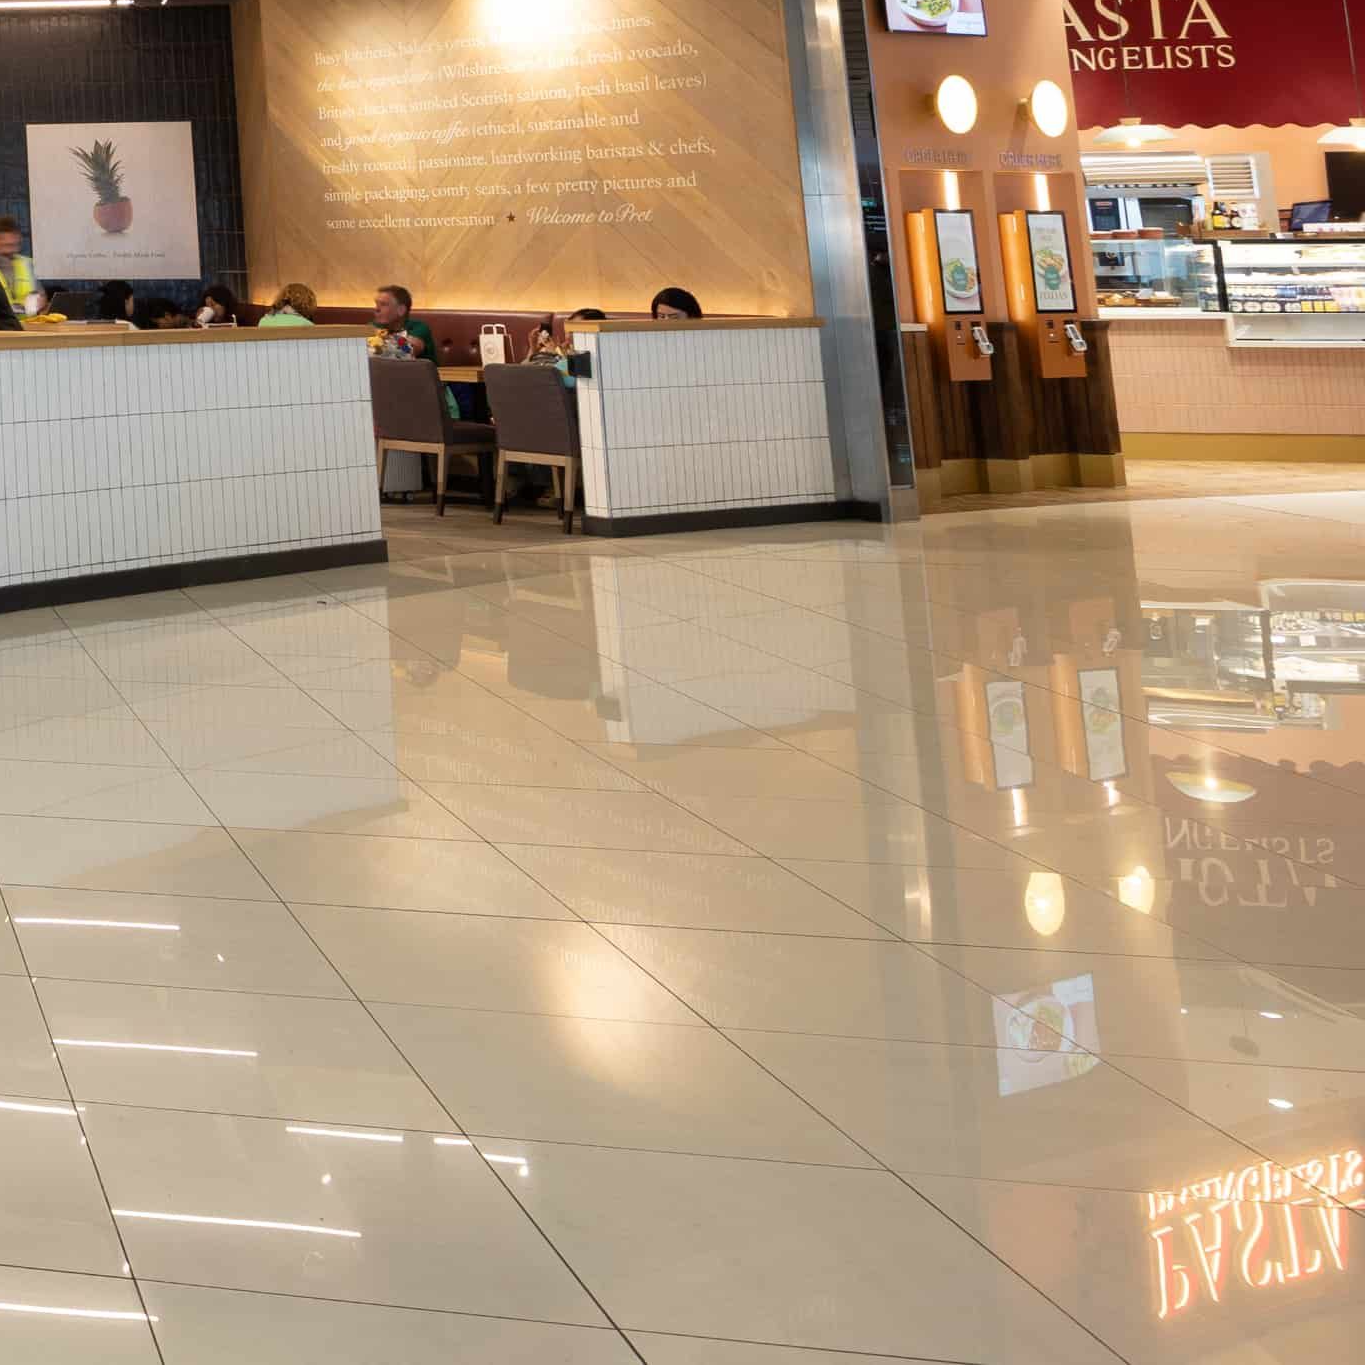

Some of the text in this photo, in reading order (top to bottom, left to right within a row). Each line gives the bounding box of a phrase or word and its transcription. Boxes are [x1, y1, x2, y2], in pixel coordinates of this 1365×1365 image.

[629, 37, 699, 60] avocado,
[1069, 44, 1236, 72] NGELISTS
[615, 74, 650, 93] basil
[654, 72, 708, 92] leaves)
[527, 113, 606, 132] sustainable
[610, 109, 640, 127] and
[491, 146, 582, 166] hardworking
[585, 143, 643, 160] baristas
[648, 140, 664, 156] &
[669, 136, 717, 157] chefs,
[364, 185, 429, 205] packaging,
[432, 183, 469, 200] comfy
[475, 182, 510, 197] seats,
[525, 177, 551, 194] few
[556, 177, 598, 196] pretty
[603, 174, 662, 194] pictures
[668, 170, 697, 188] and
[326, 203, 654, 230] some excellent conversation Welcome to Pret
